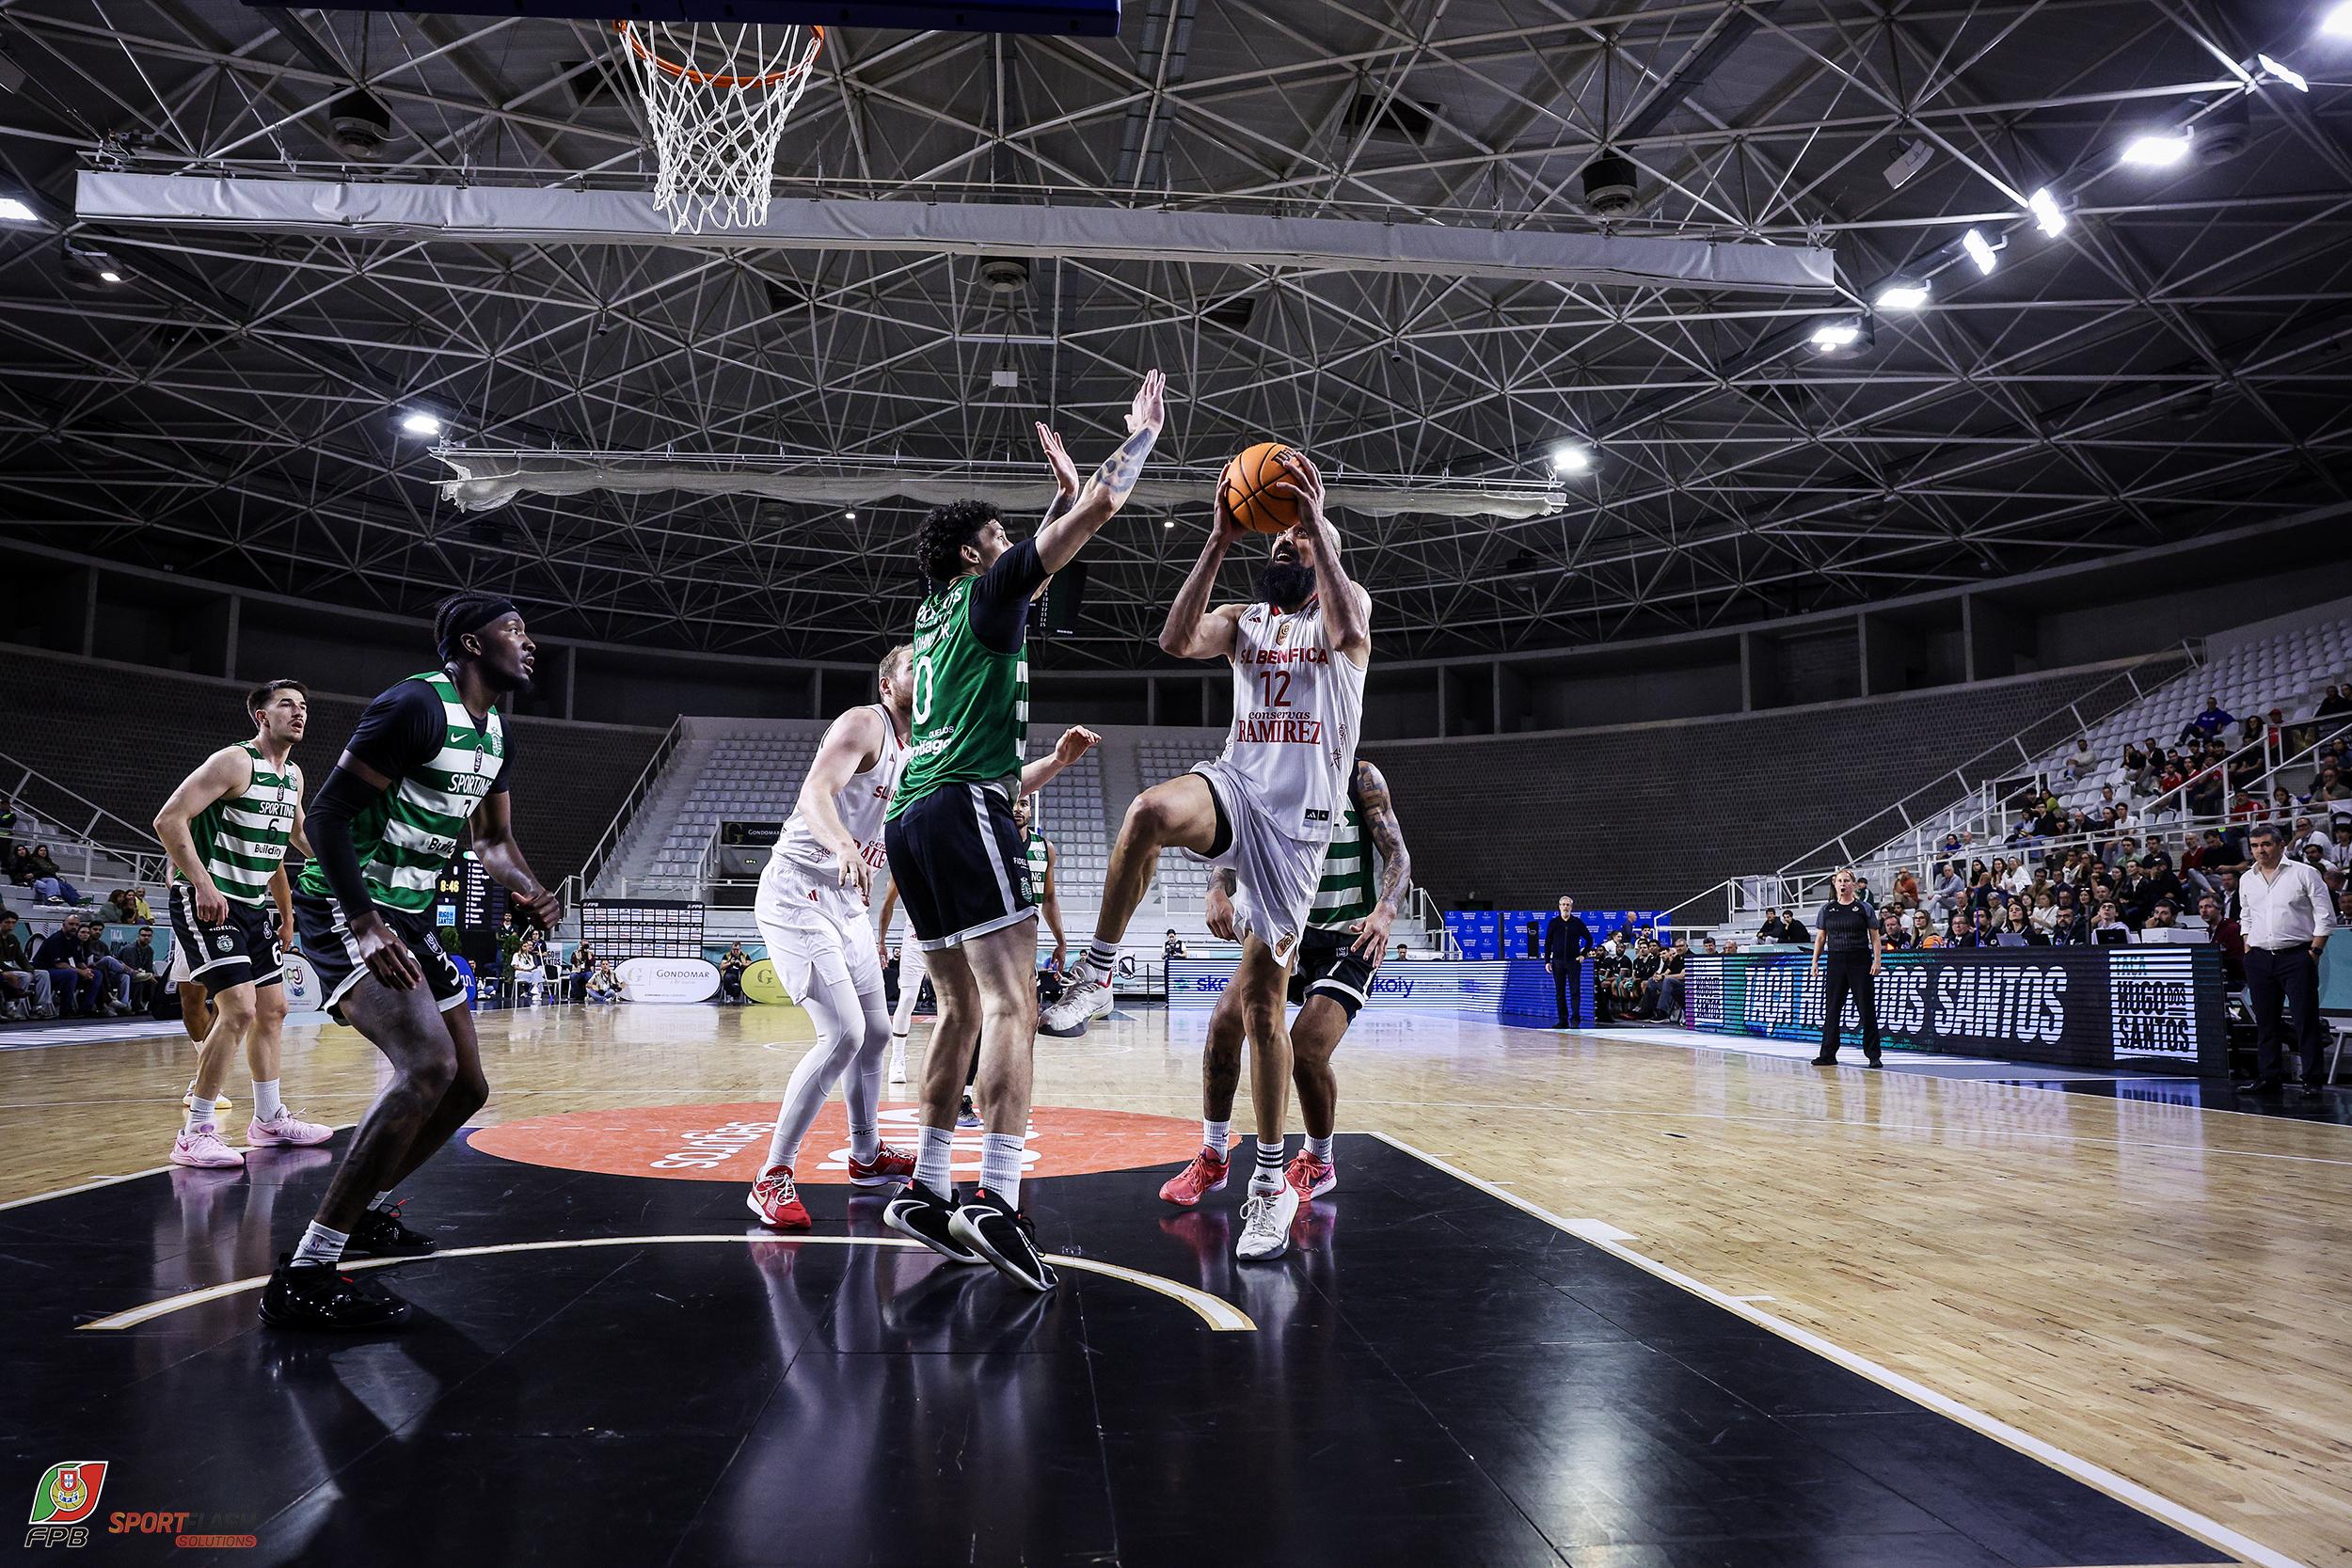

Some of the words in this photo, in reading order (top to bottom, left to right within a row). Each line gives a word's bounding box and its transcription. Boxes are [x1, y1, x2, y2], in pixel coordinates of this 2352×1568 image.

[1256, 647, 1328, 665] BENFICA
[913, 656, 933, 725] 0
[1260, 671, 1292, 707] 12
[1248, 711, 1311, 720] conservas
[1237, 721, 1322, 745] RAMIREZ
[267, 818, 279, 842] 6
[440, 879, 459, 893] 8:46
[272, 942, 283, 966] 6
[656, 969, 710, 978] GONDOMAR
[1743, 967, 1792, 1035] TAÇA
[1873, 965, 1928, 1035] DOS
[1933, 965, 2068, 1045] SANTOS
[2117, 981, 2166, 1015] HUGO
[2119, 1016, 2190, 1053] SANTOS
